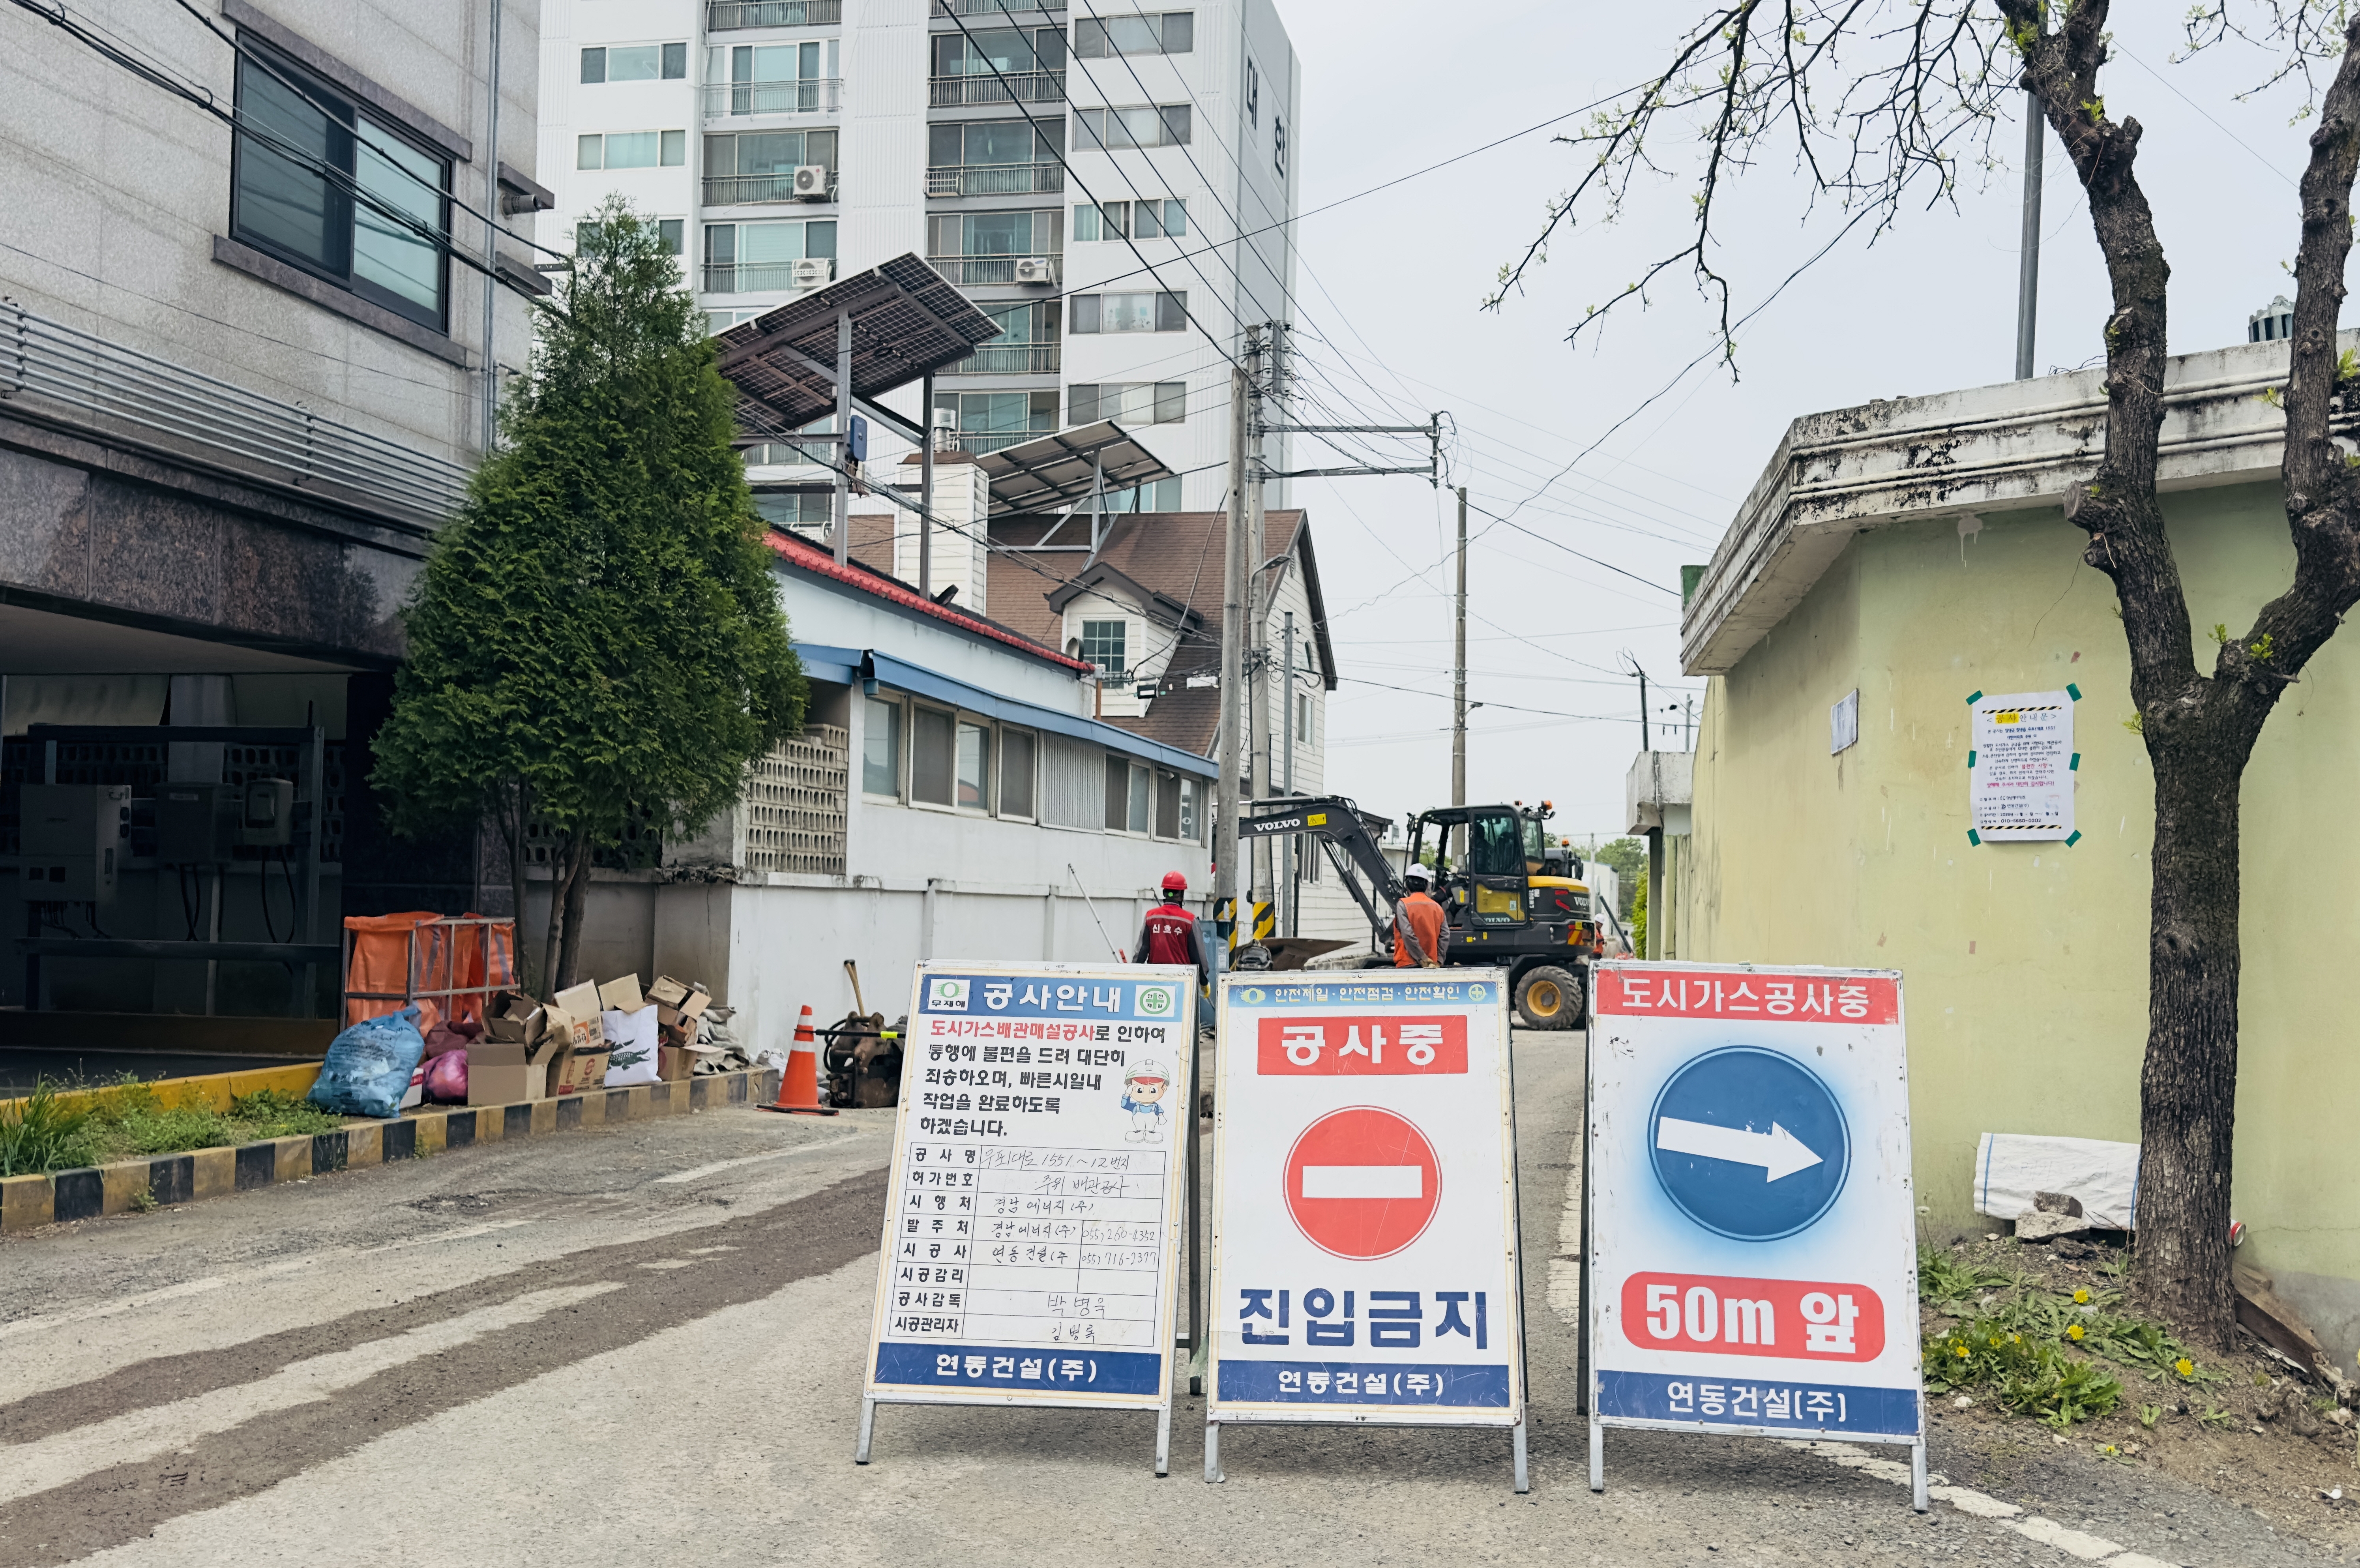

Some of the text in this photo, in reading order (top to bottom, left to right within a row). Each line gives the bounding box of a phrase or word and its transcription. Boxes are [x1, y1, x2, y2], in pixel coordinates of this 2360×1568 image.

[1254, 818, 1300, 832] VOLVO
[1152, 924, 1182, 935] 신호수
[983, 983, 1121, 1013] 공사안내
[1274, 985, 1459, 1003] 안전제일 안전점검 안전확인
[1622, 978, 1870, 1017] 도시가스공사중
[931, 1019, 1166, 1044] 도시가스배관매설공사로 인하여
[929, 1044, 1125, 1067] 통행에 불편을 드려 대단히
[1281, 1025, 1443, 1066] 공사중
[925, 1068, 1101, 1091] 죄송하오며, 빠른시일내
[923, 1093, 1060, 1115] 작업을 완료하도록
[920, 1117, 1008, 1137] 하겠습니다.
[1073, 1176, 1130, 1198] 배관공사
[895, 1316, 959, 1333] 시공관리자
[1240, 1288, 1487, 1349] 진입금지
[1646, 1284, 1859, 1354] 50m 앞
[937, 1353, 1097, 1383] 연동건설(주)
[1278, 1370, 1444, 1397] 연동건설(주)
[1667, 1381, 1847, 1422] 연동건설(주)
